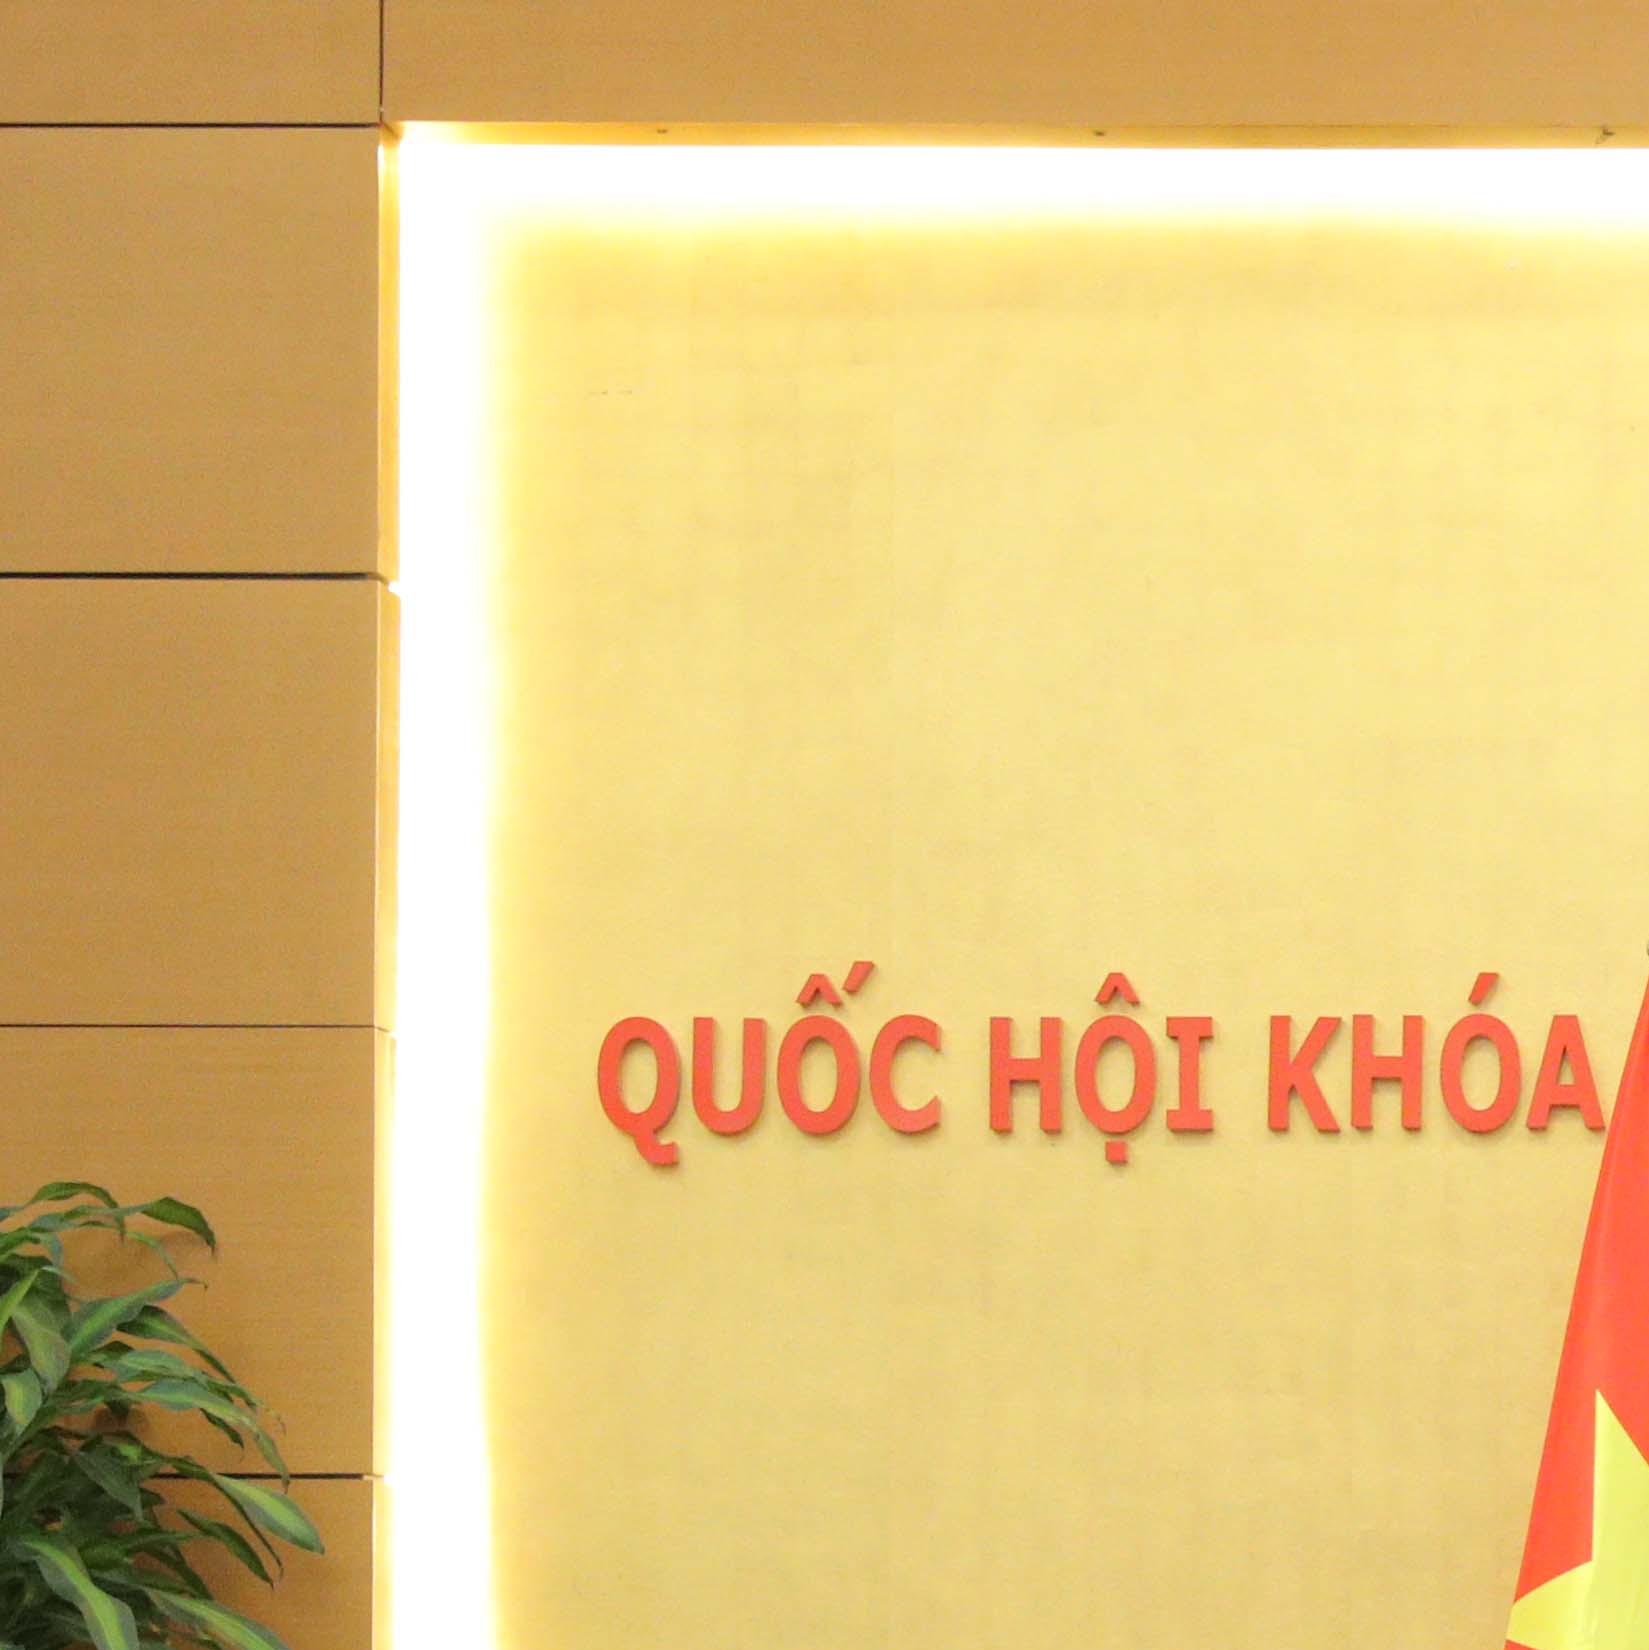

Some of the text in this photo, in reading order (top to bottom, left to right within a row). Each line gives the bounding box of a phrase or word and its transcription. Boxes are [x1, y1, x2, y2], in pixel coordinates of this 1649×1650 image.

[598, 961, 939, 1165] QUỐC
[990, 972, 1213, 1163] HỘI
[1268, 972, 1606, 1133] KHÓA
